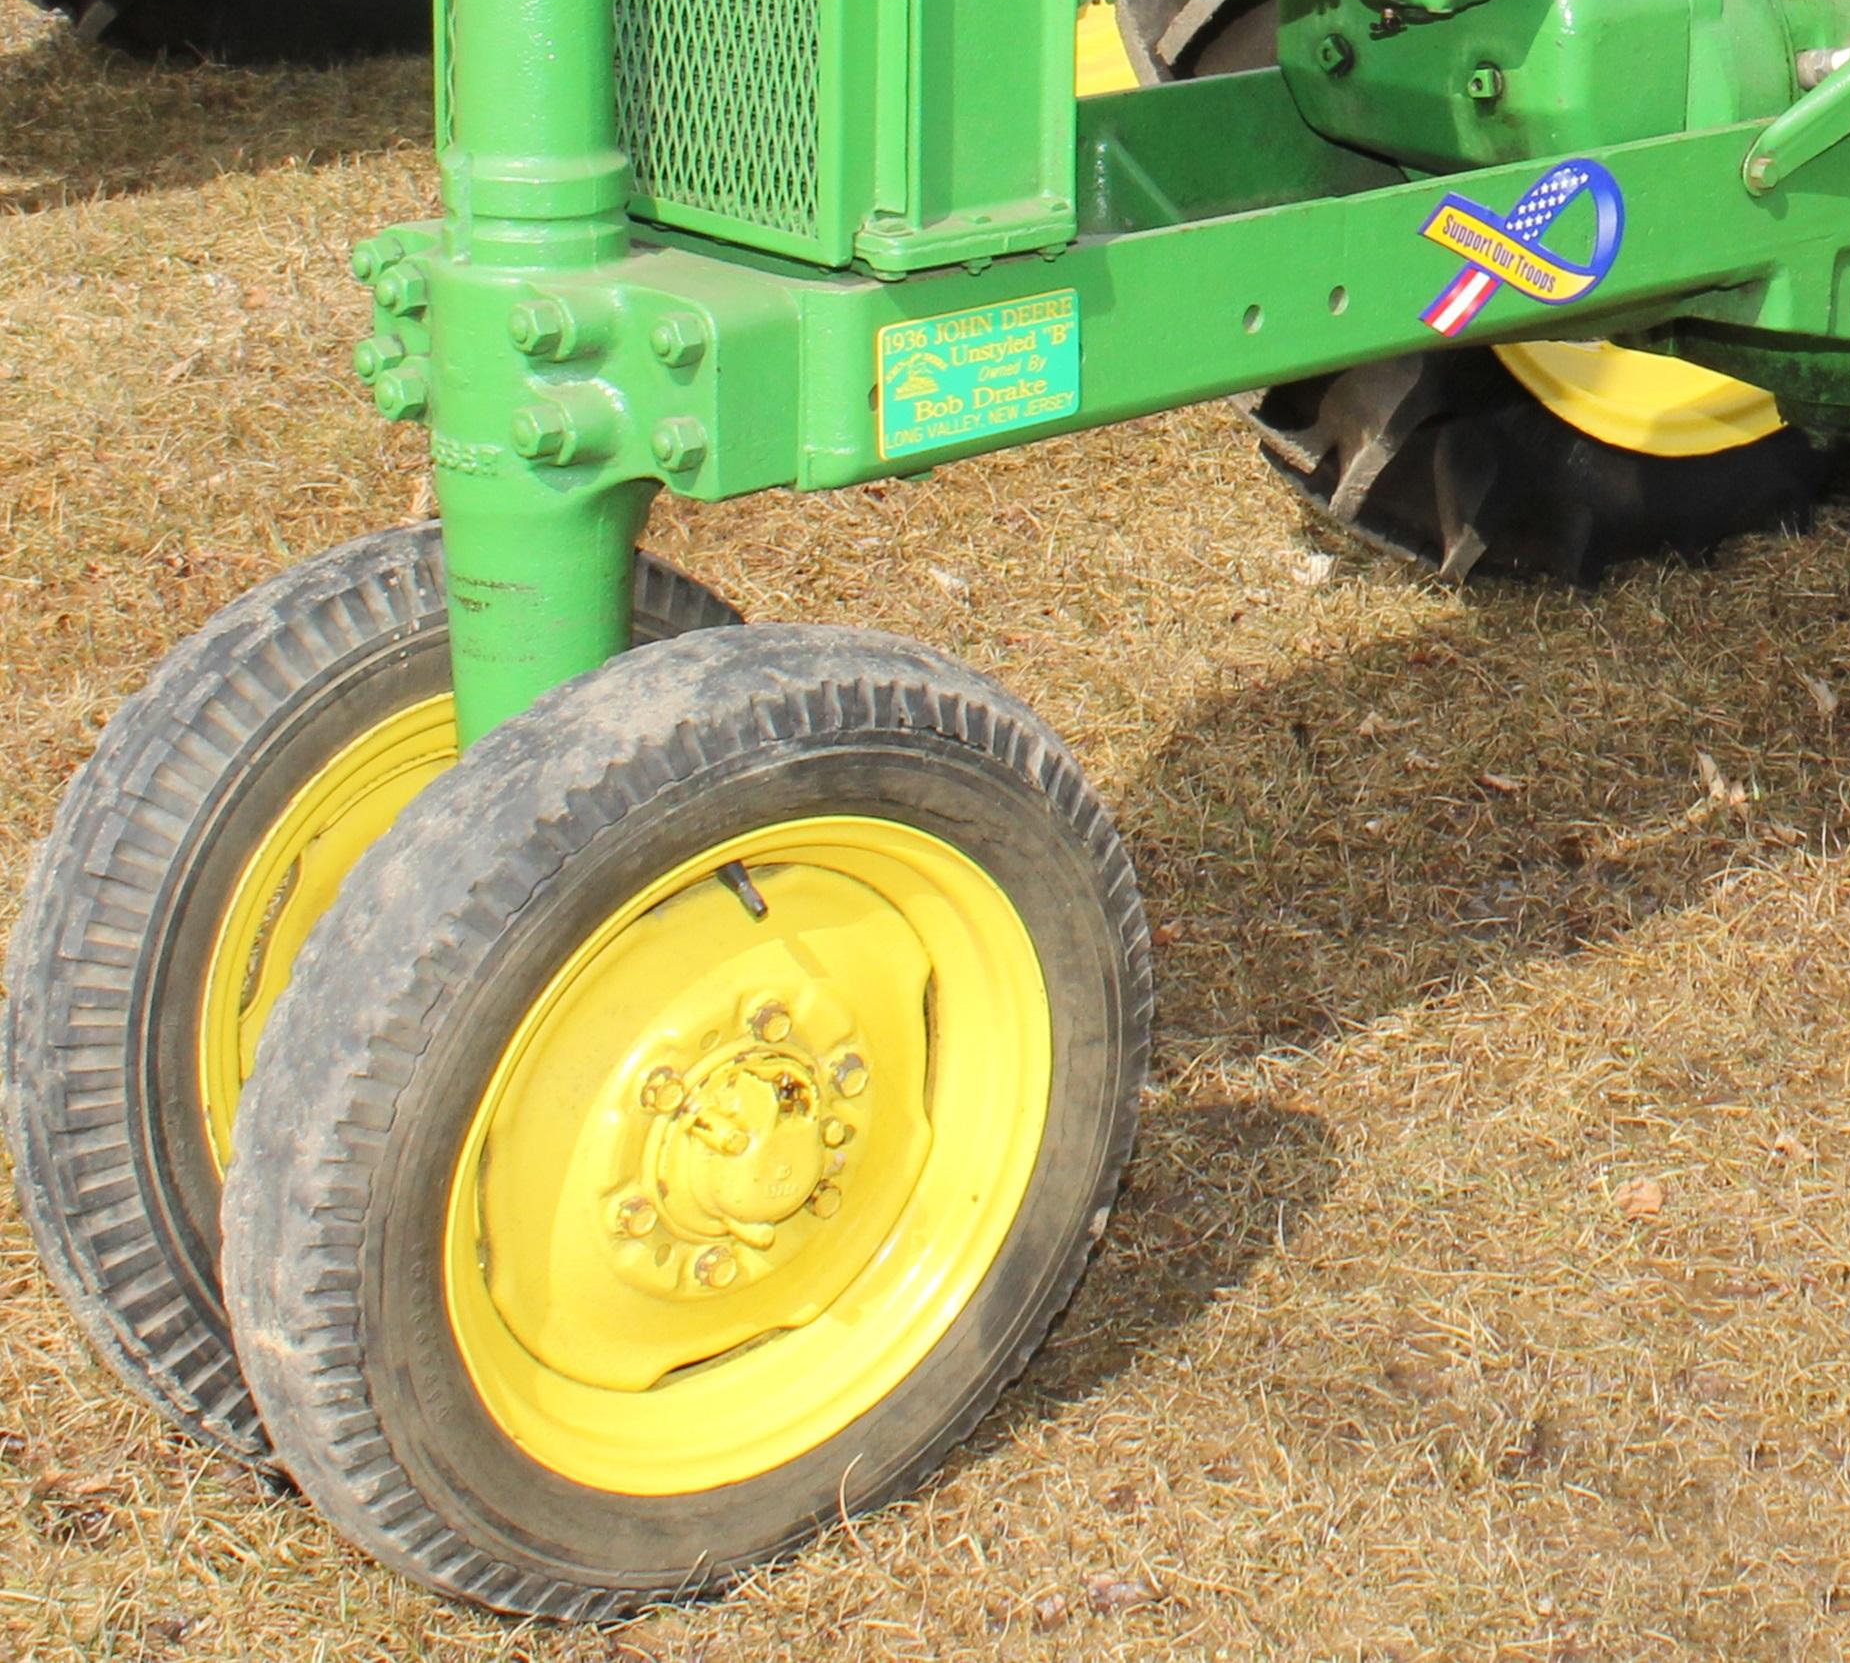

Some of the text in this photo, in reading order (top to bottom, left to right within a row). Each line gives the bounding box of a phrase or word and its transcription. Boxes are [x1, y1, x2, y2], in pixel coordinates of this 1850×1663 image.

[1443, 214, 1557, 294] Support Our Troops
[884, 296, 1073, 356] 1936 JOHN DEERE
[949, 330, 1037, 367] Unstyled
[977, 354, 1048, 384] Owned By
[883, 427, 924, 450] LONG
[989, 404, 1019, 425] NEW
[1024, 390, 1075, 417] JERSEY
[914, 378, 1049, 423] Bob Drake
